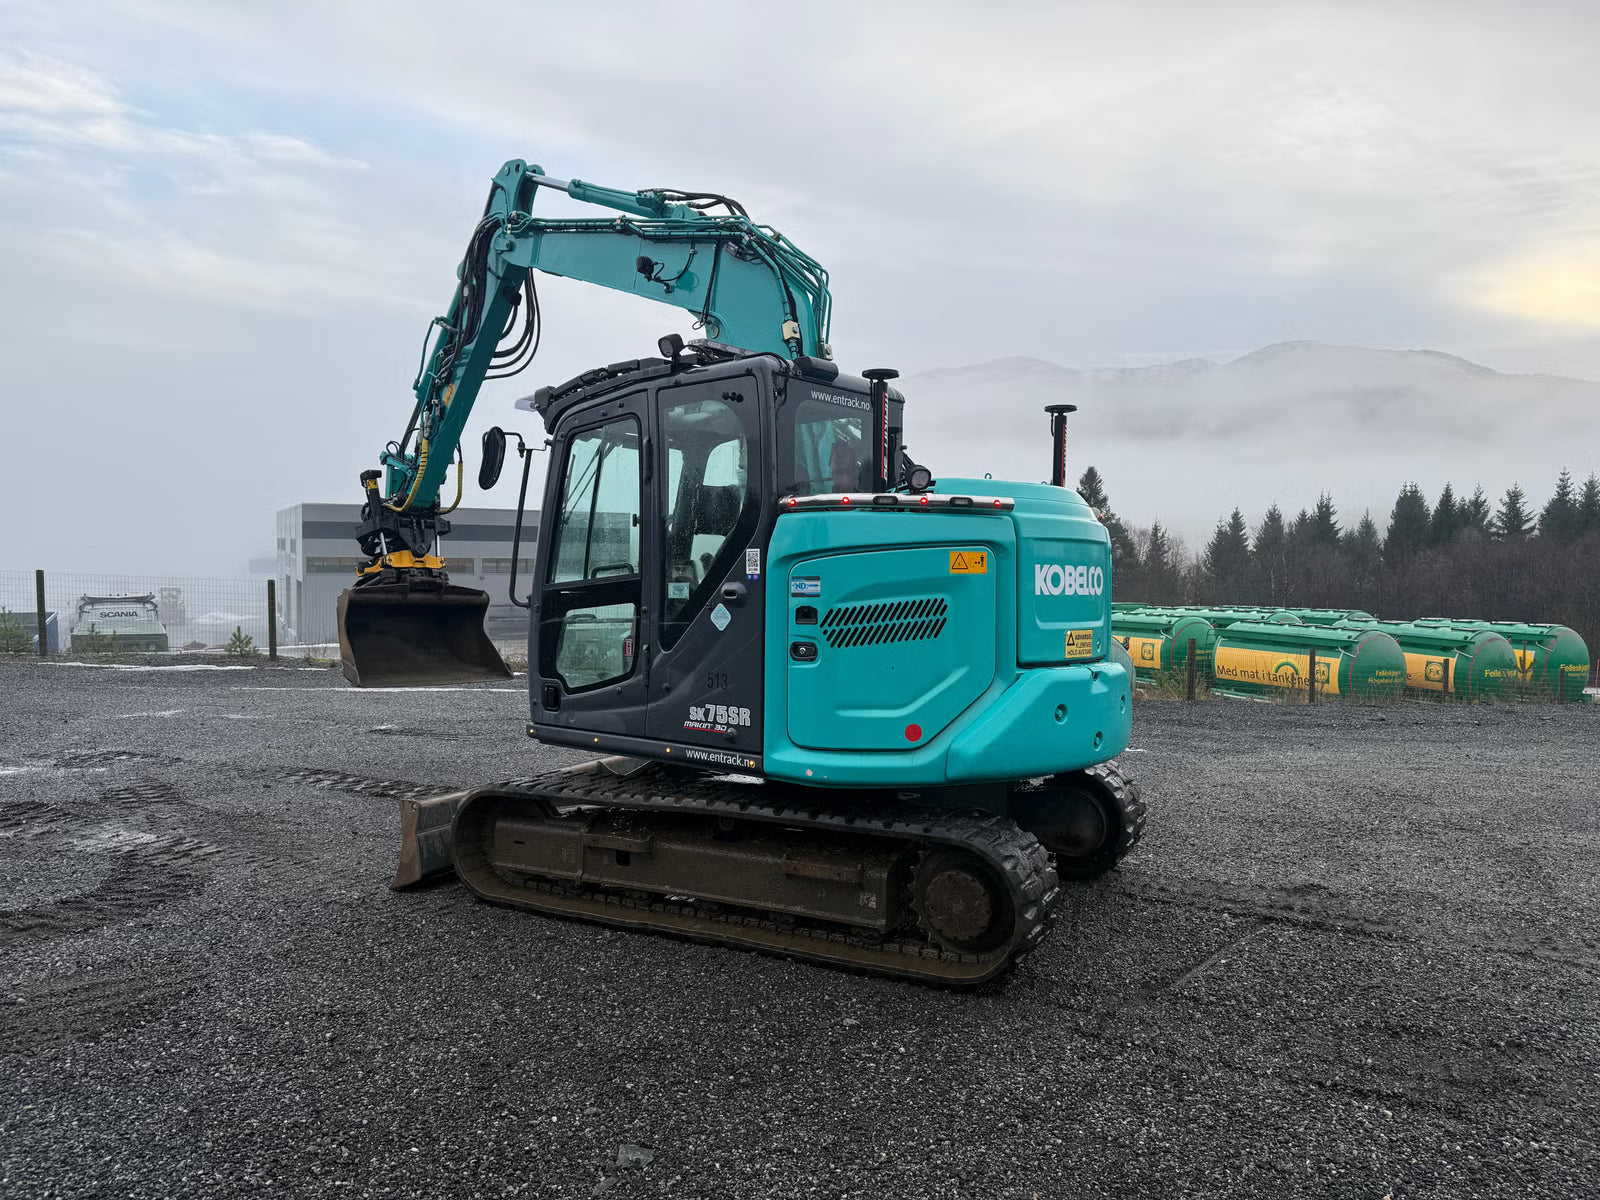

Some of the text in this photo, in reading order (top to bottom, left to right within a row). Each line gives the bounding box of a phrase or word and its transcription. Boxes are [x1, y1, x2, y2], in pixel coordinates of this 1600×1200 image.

[810, 390, 870, 411] www.entrack.no
[1035, 564, 1104, 596] KOBELCO
[707, 672, 728, 690] 513
[1217, 664, 1238, 677] Med
[1240, 669, 1260, 680] mat
[689, 703, 751, 727] SK75SR
